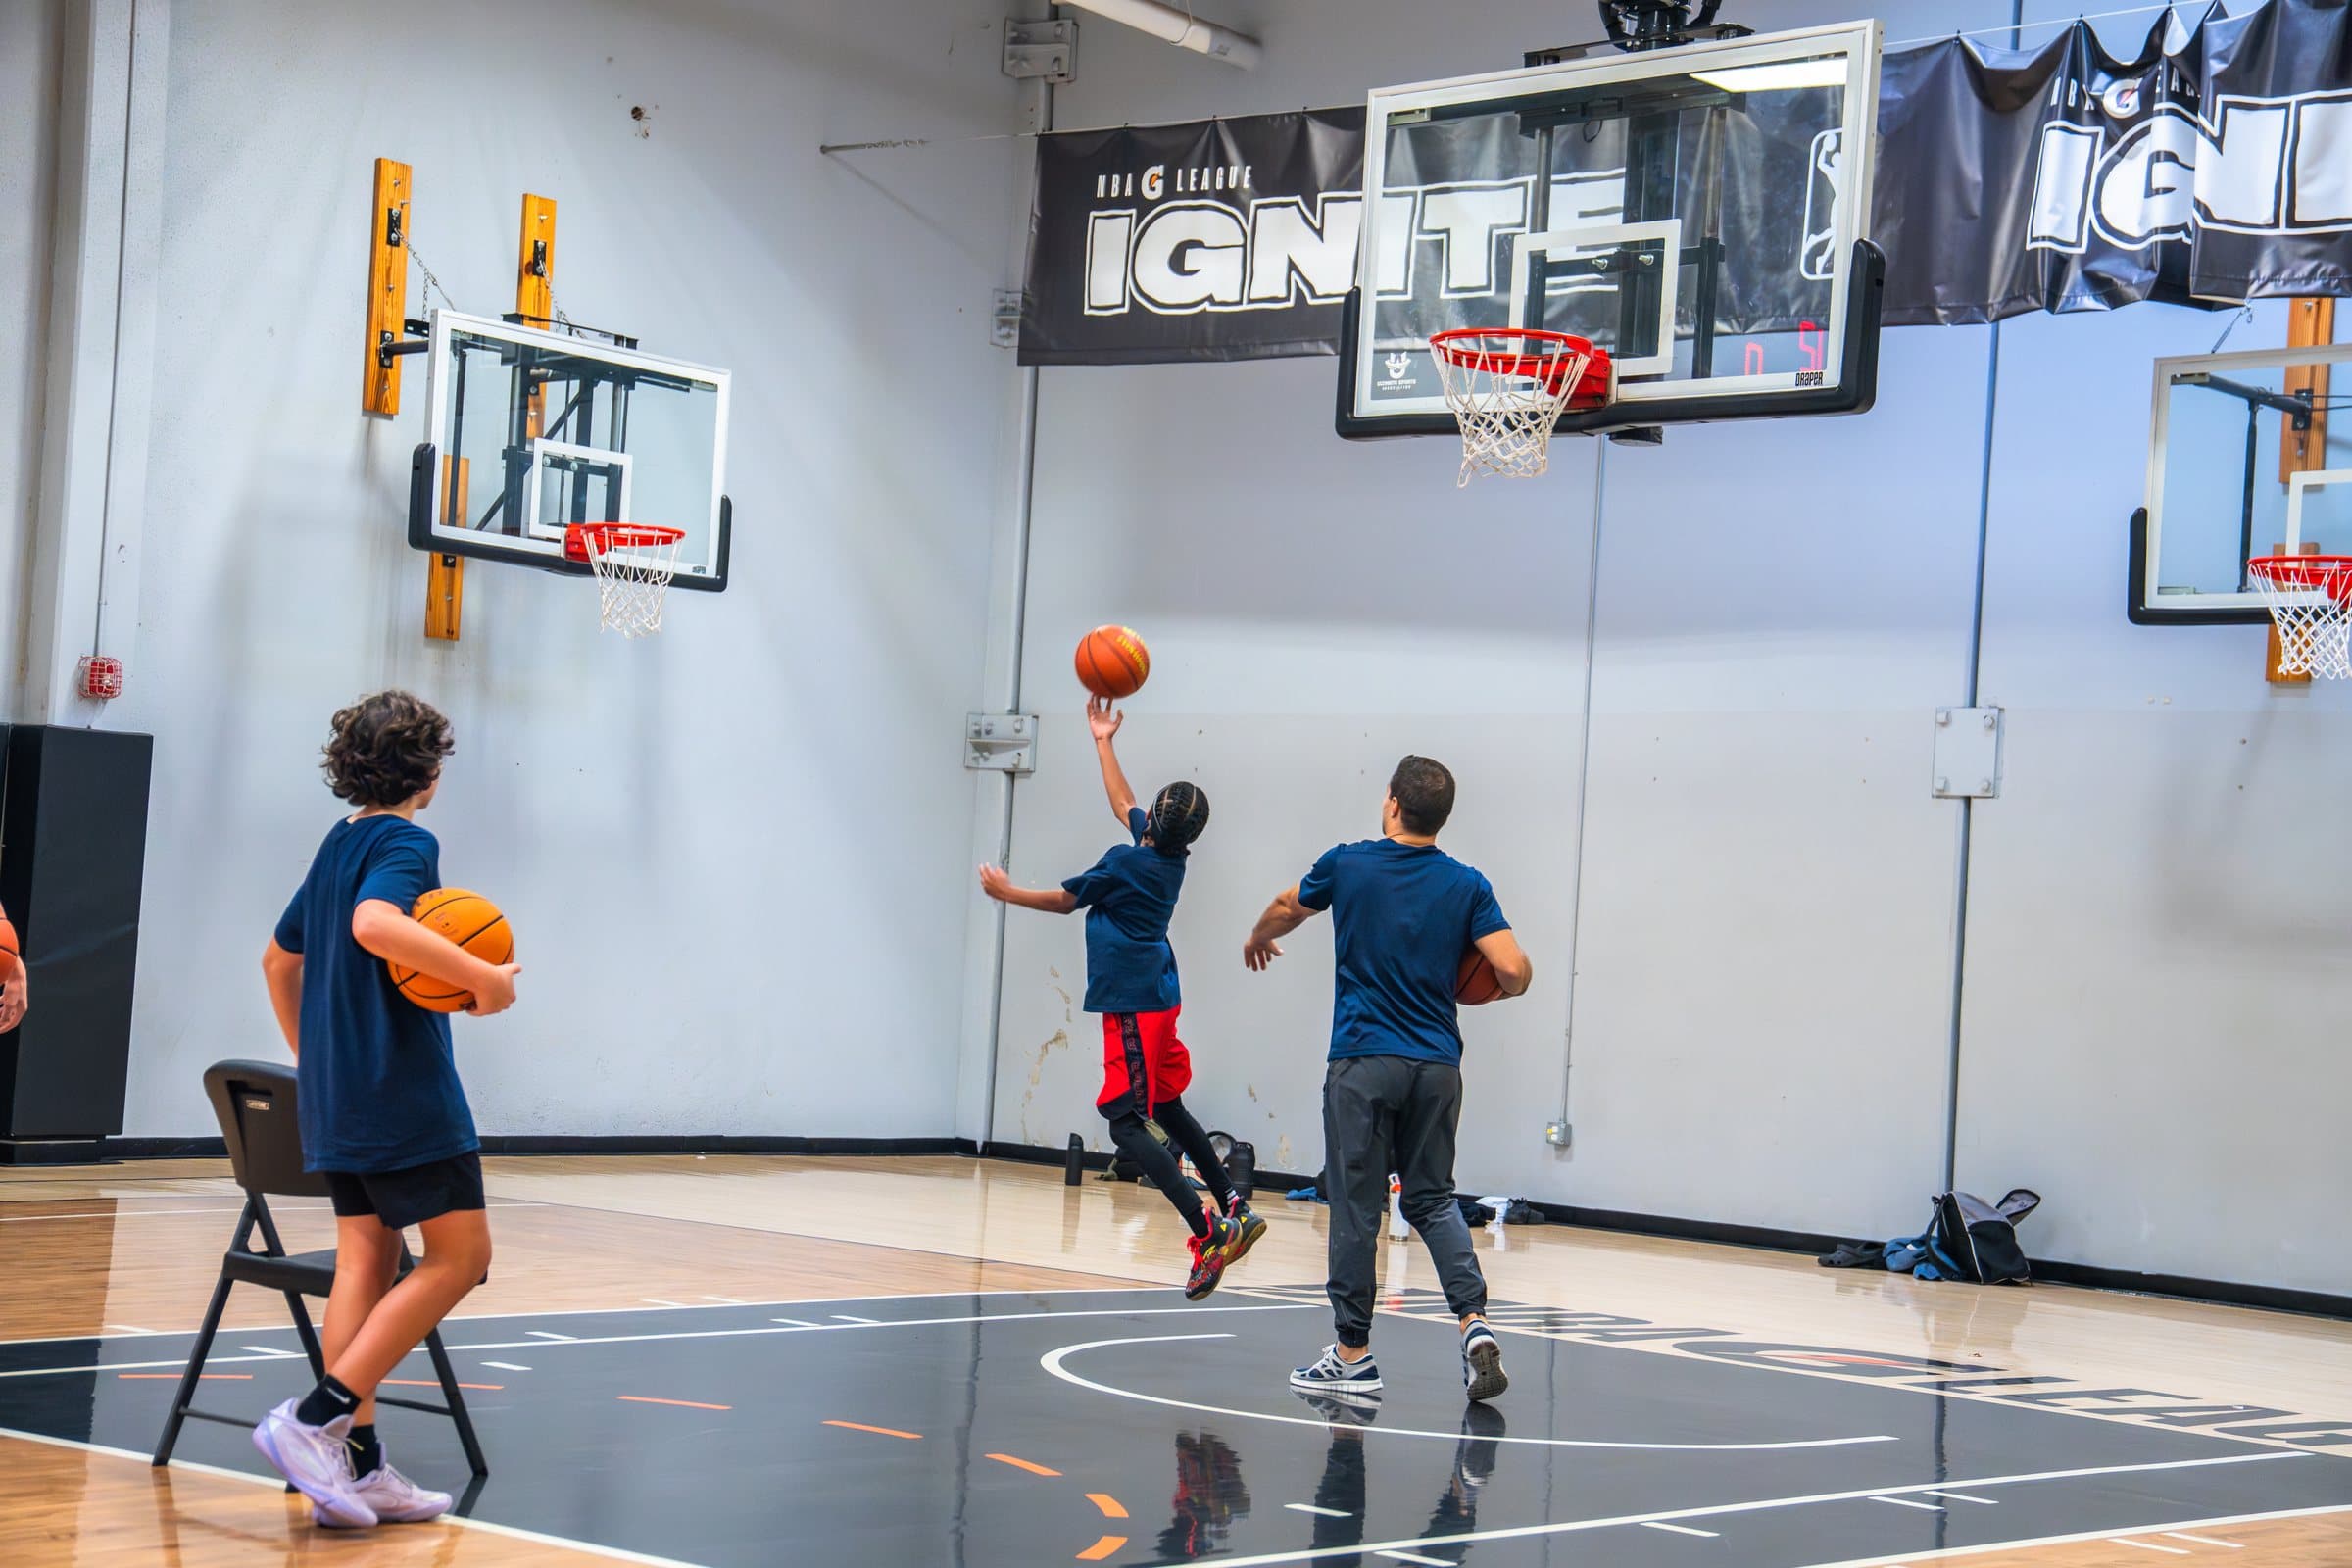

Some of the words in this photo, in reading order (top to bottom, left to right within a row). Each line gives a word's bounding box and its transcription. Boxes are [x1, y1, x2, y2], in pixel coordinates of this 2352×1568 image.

[1097, 173, 1133, 198] NBA
[1141, 165, 1164, 200] G
[1176, 165, 1251, 192] LEAGUE
[1084, 169, 1624, 316] IGNITE
